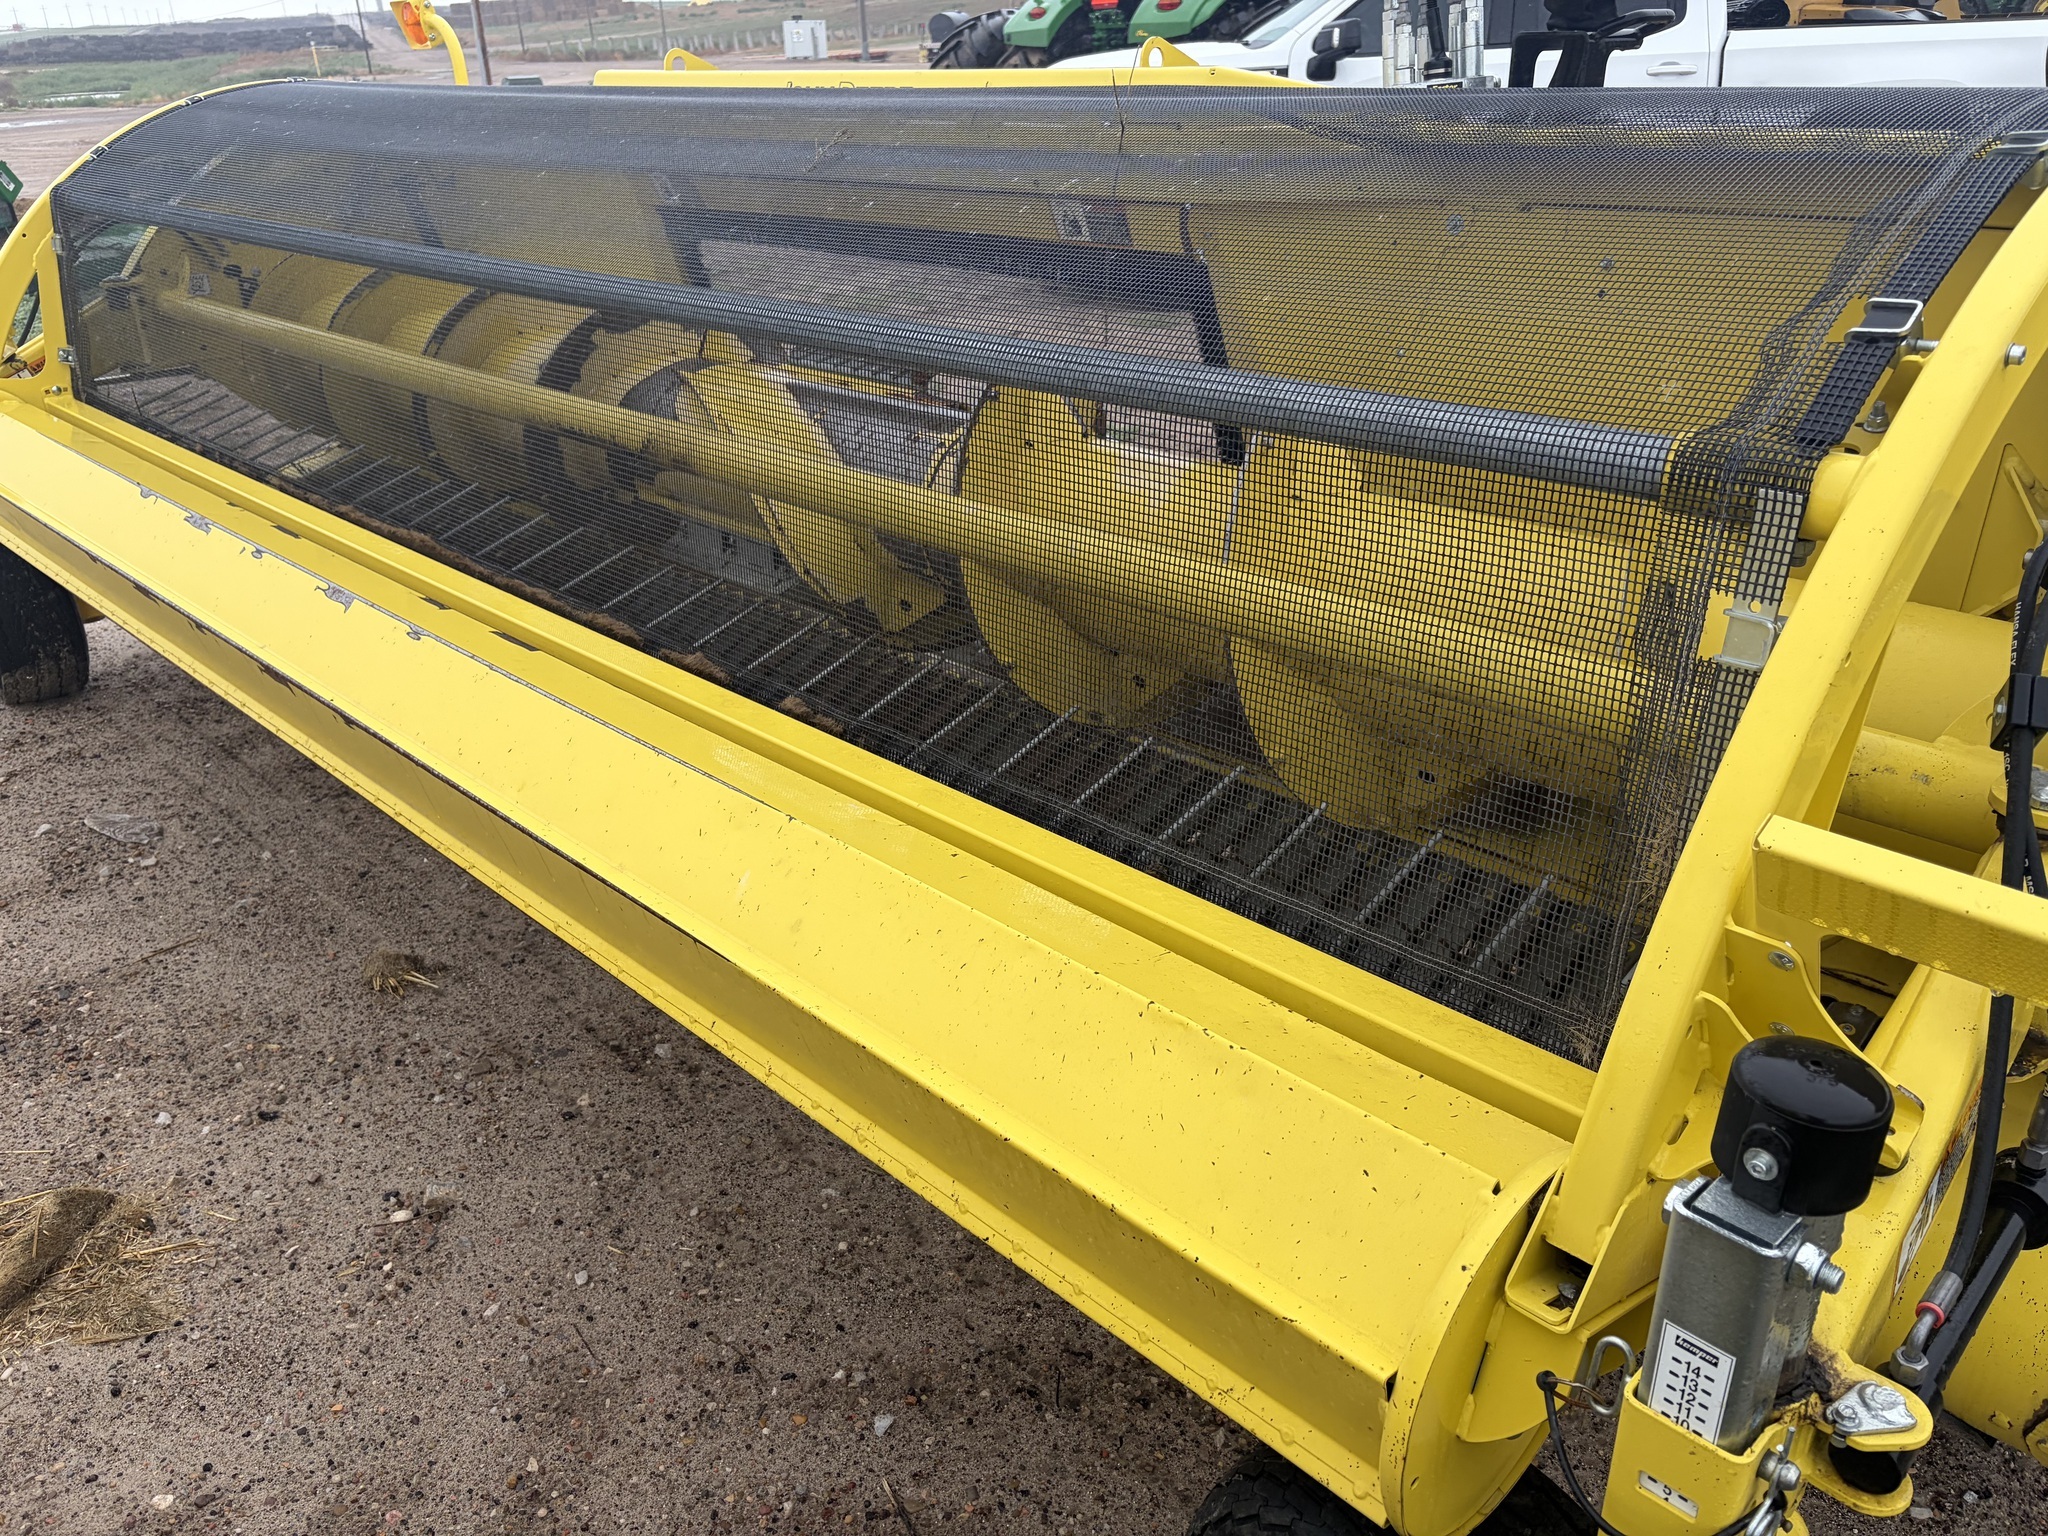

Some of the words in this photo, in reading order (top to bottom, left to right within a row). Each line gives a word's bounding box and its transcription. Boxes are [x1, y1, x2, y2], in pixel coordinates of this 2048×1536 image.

[1684, 1361, 1701, 1379] 14
[1682, 1375, 1699, 1392] 13
[1679, 1389, 1696, 1407] 12
[1676, 1402, 1691, 1419] 11
[1673, 1416, 1690, 1430] 10
[1663, 1484, 1672, 1496] 5
